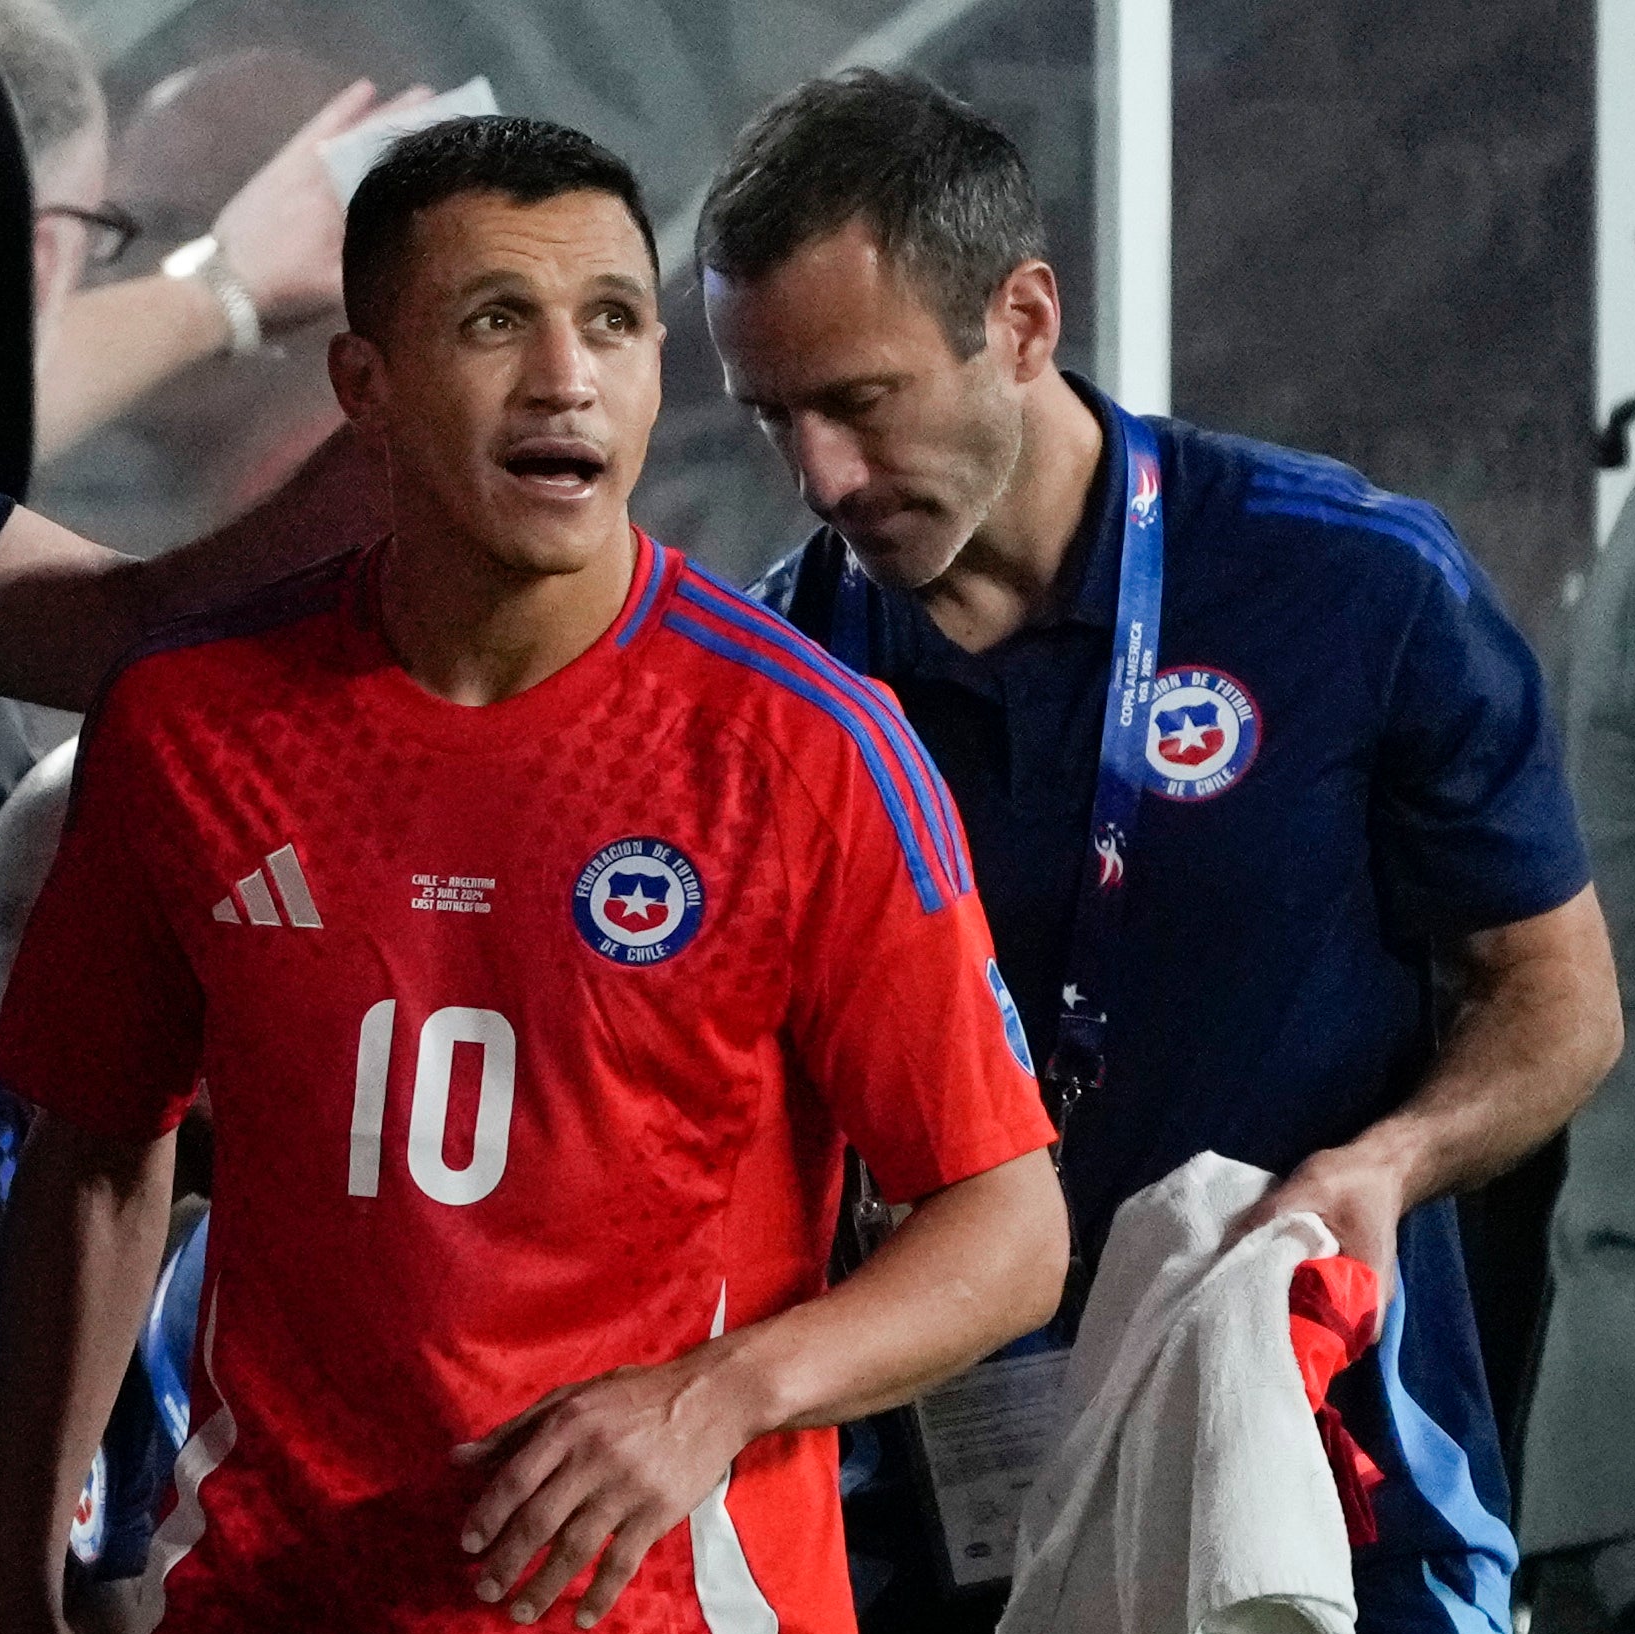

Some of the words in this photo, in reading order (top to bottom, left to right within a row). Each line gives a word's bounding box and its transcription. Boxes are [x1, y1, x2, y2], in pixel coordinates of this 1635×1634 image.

[1126, 619, 1143, 688] AMERICA
[1119, 688, 1136, 727] COPA
[1138, 680, 1150, 703] USA
[1214, 678, 1255, 724] FUTBOL
[1195, 768, 1235, 797] CHILE
[411, 873, 439, 887] CHILE
[448, 876, 496, 889] ARGENTINA
[575, 841, 643, 898] FEDERACION
[652, 843, 672, 861] DE
[671, 858, 702, 908] FUTBOL
[599, 939, 621, 957] DE
[626, 943, 667, 962] CHILE
[348, 998, 517, 1206] 10
